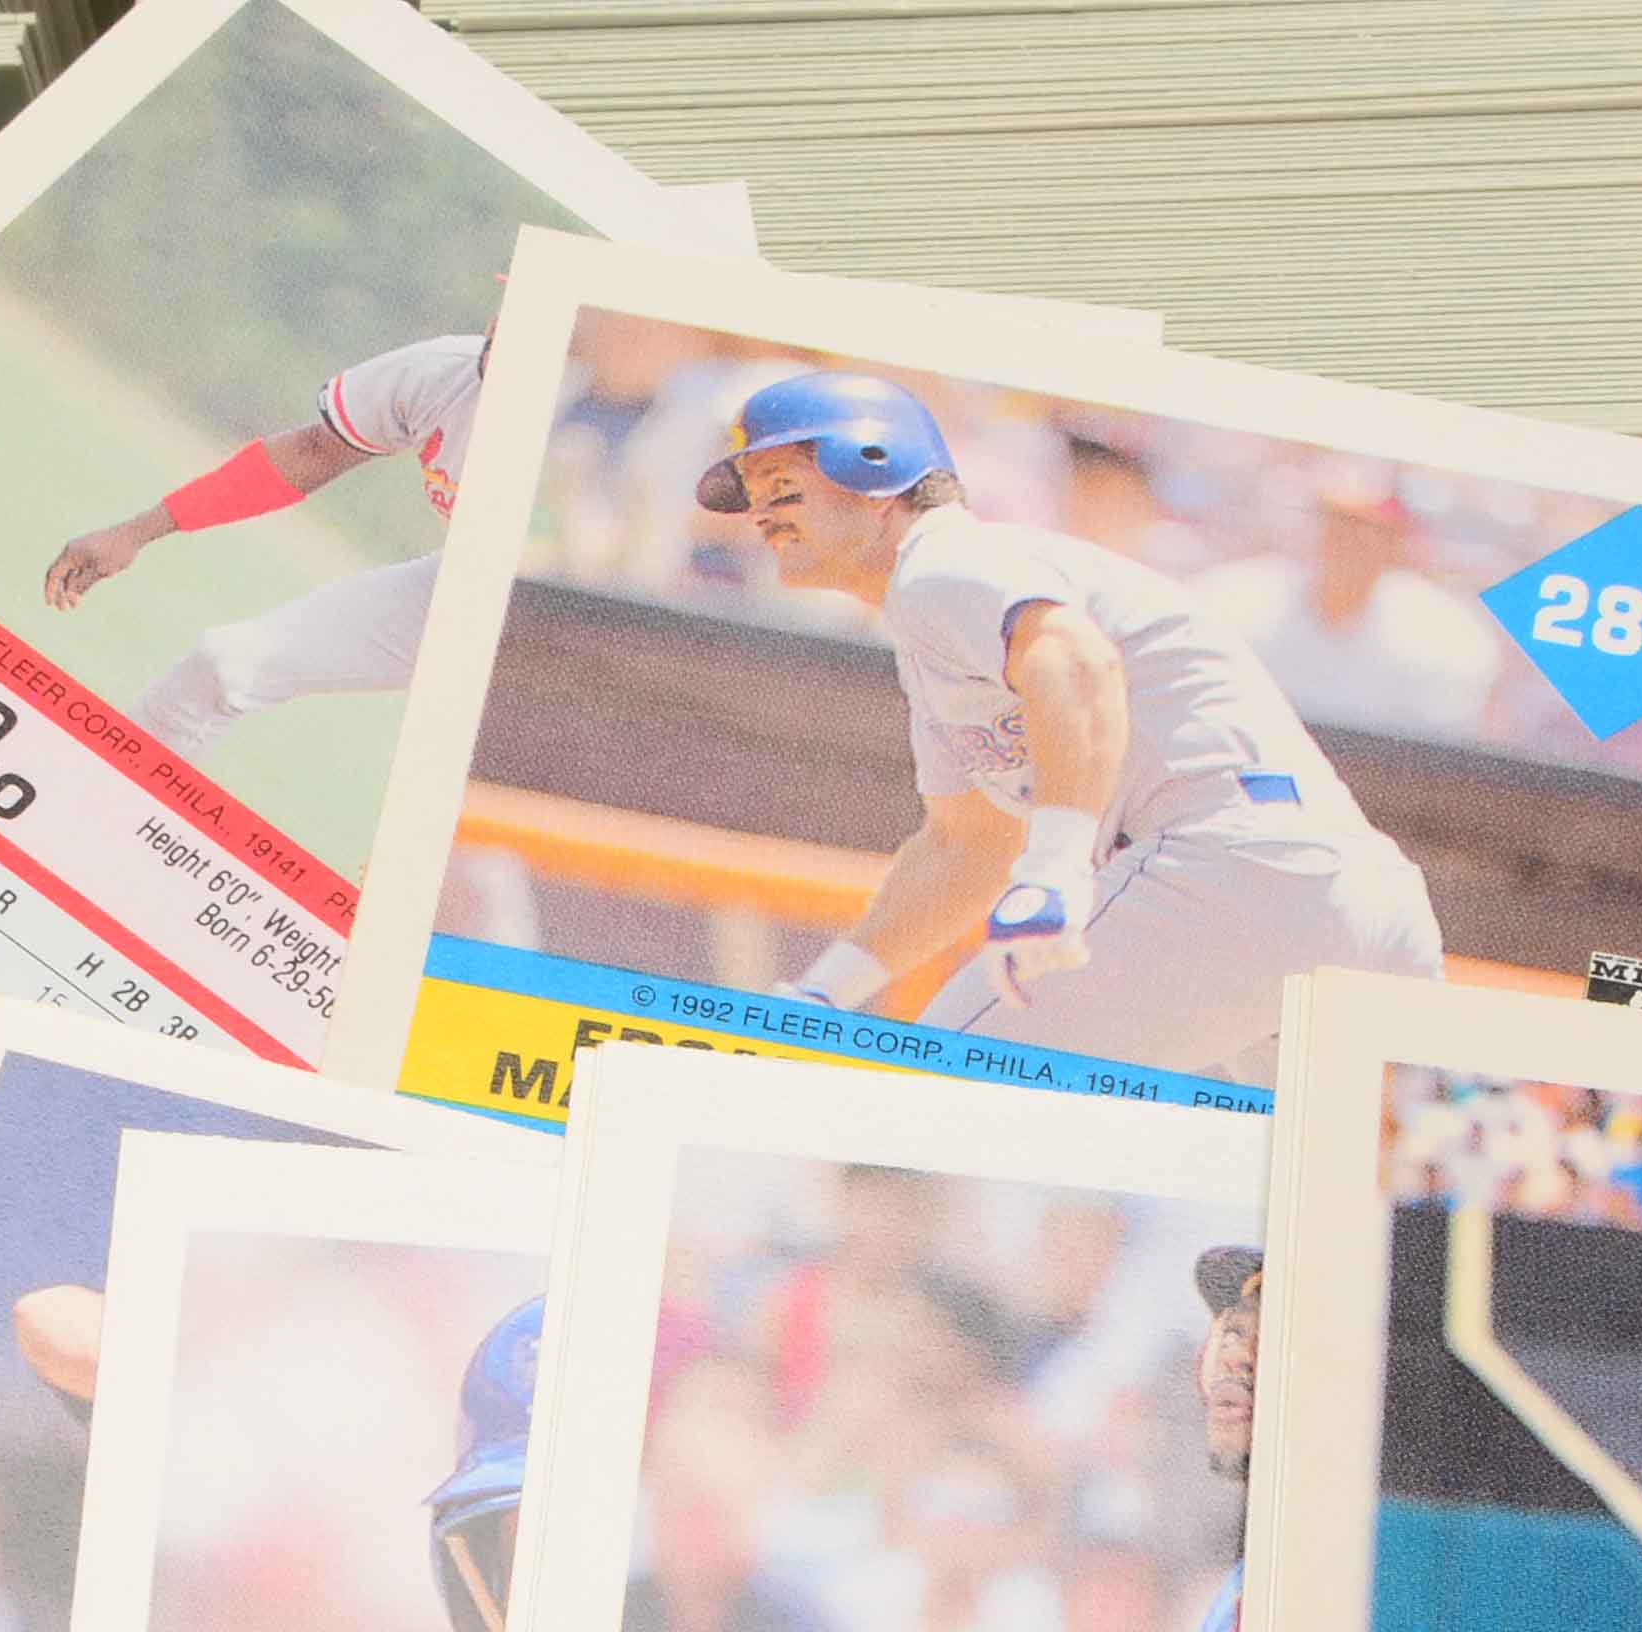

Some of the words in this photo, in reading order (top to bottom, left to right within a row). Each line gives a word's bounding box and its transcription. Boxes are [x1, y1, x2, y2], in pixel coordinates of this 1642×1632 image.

[135, 815, 212, 881] Height
[262, 907, 343, 977] Weight
[244, 832, 308, 883] 19141
[194, 901, 252, 953] Born
[671, 993, 735, 1025] 1992
[742, 1004, 844, 1046] FLEER
[1086, 1072, 1159, 1104] 19141
